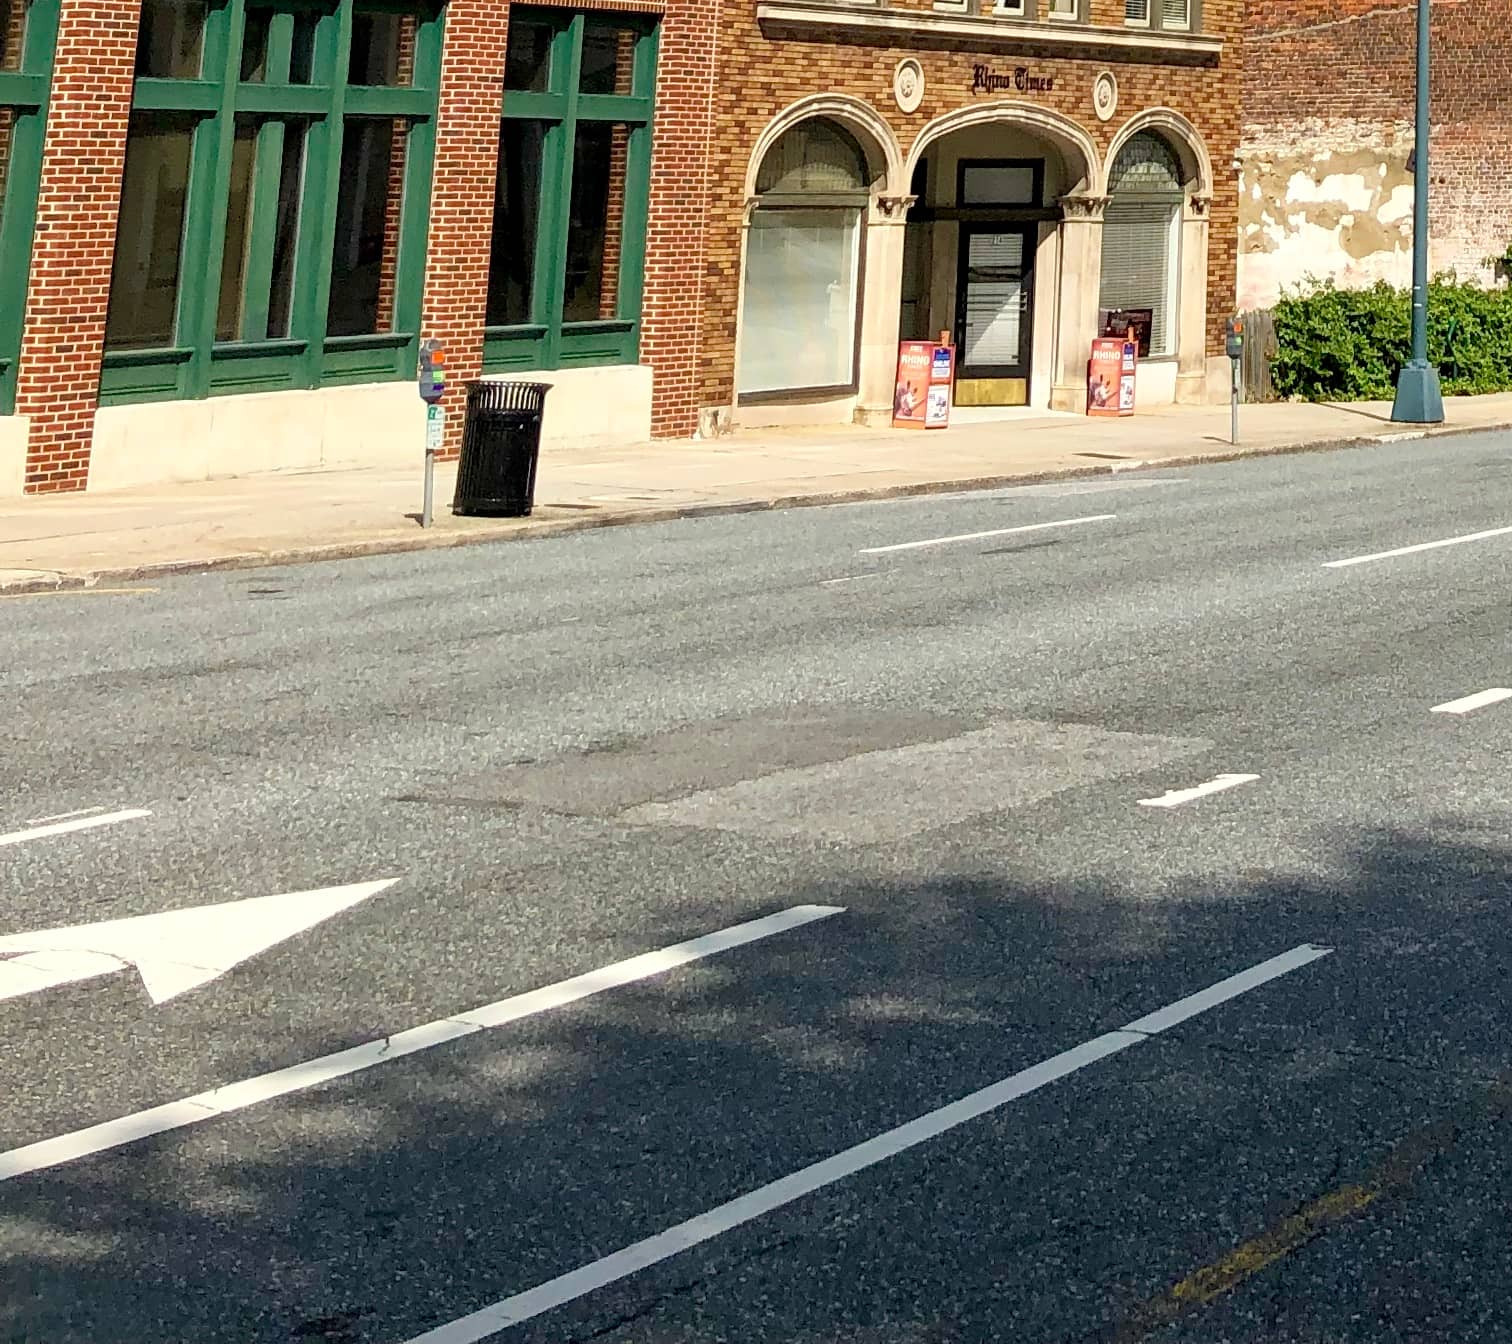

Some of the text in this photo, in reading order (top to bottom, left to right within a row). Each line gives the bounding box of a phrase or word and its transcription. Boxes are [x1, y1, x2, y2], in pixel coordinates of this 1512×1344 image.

[971, 64, 1054, 95] Rhino Times
[901, 354, 930, 366] RHINO
[1093, 350, 1121, 361] RHINO
